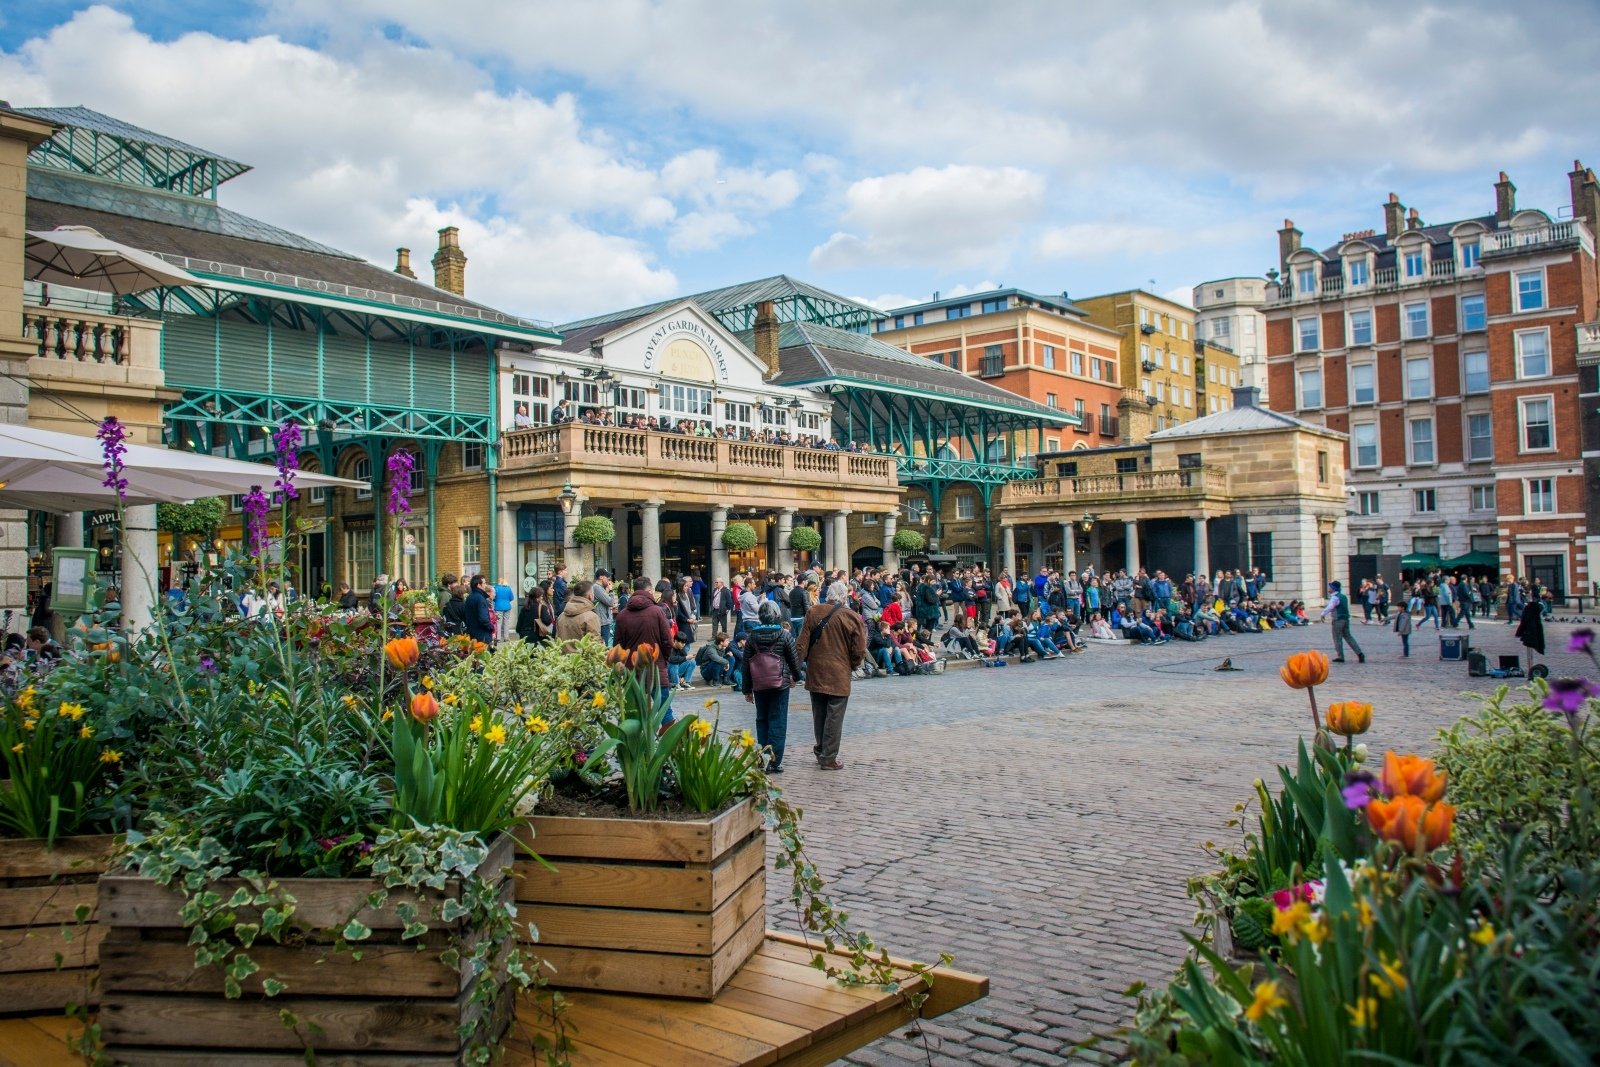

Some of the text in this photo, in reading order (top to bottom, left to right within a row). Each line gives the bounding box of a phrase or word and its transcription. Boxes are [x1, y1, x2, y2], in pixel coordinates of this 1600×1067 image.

[643, 320, 729, 384] COVENT GARDEN MARKET
